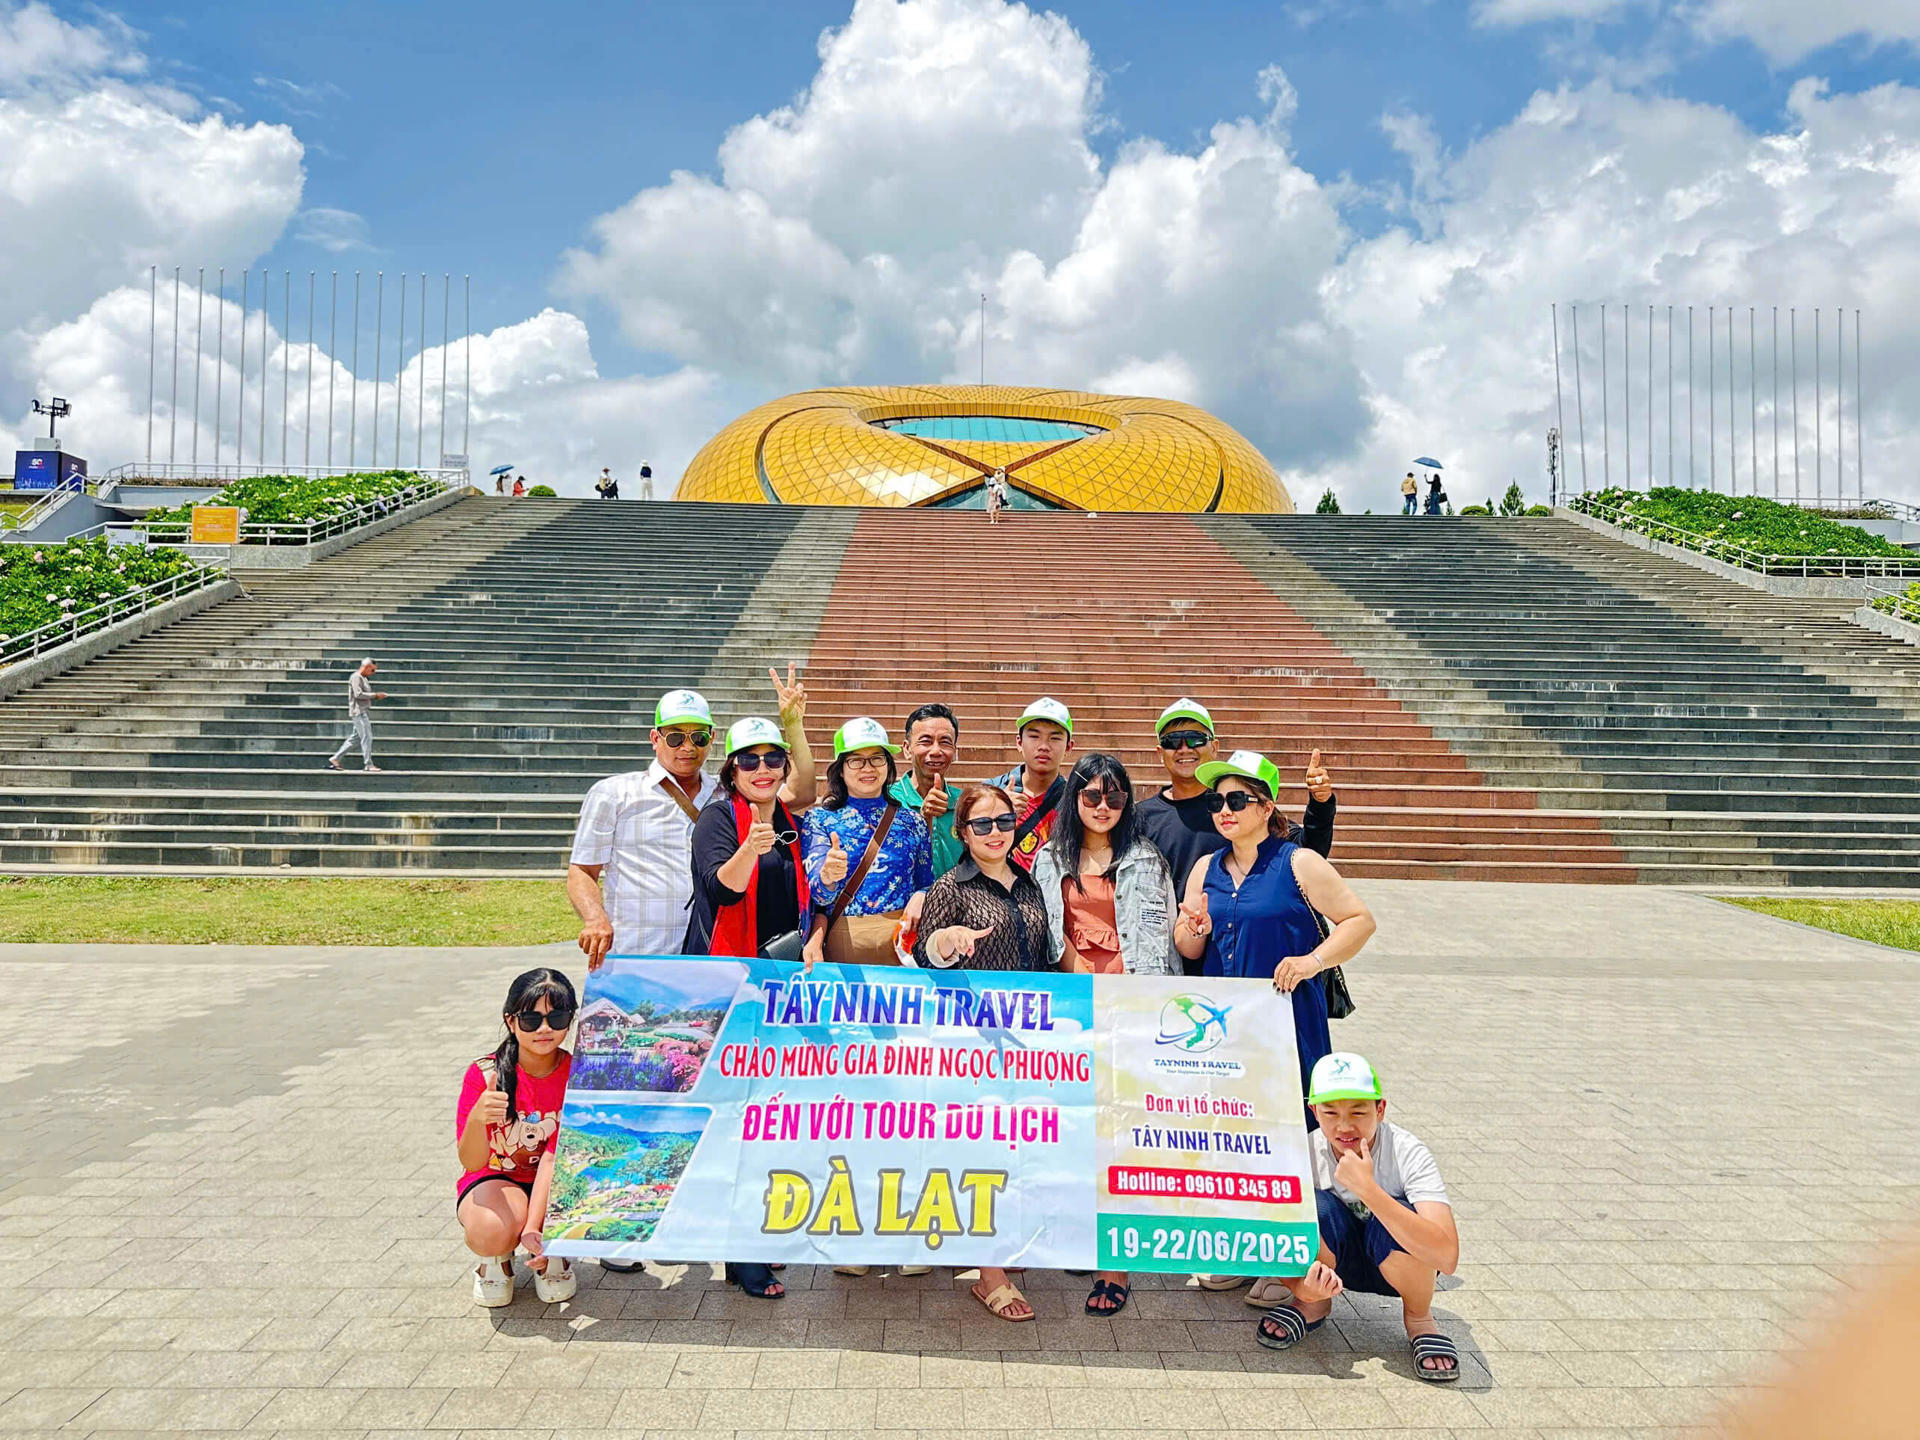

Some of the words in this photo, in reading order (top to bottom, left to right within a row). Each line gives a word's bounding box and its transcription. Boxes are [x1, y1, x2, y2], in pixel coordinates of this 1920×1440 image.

[763, 975, 829, 1025] TÂY
[833, 982, 924, 1026] NINH
[934, 988, 1055, 1031] TRAVEL
[720, 1038, 775, 1077] CHÀO
[781, 1038, 838, 1077] MỪNG
[844, 1045, 877, 1077] GIA
[883, 1039, 932, 1077] ĐÌNH
[939, 1047, 998, 1085] NGỌC
[1003, 1049, 1090, 1088] PHƯỢNG
[1154, 1059, 1199, 1068] TAYNINH
[1201, 1061, 1241, 1070] TRAVEL
[742, 1092, 798, 1141] ĐẾN
[810, 1094, 854, 1141] VỚI
[863, 1101, 936, 1140] TOUR
[945, 1103, 983, 1141] DU
[993, 1105, 1059, 1150] LỊCH
[1146, 1094, 1173, 1112] Đơn
[1177, 1096, 1190, 1117] vị
[1194, 1093, 1208, 1114] tổ
[1212, 1098, 1253, 1117] chức:
[1132, 1125, 1165, 1148] TÂY
[1167, 1130, 1209, 1151] NINH
[1213, 1132, 1272, 1155] TRAVEL
[761, 1155, 864, 1236] ĐÀ
[873, 1167, 1009, 1251] LẠT
[1117, 1171, 1182, 1193] Hotline:
[1185, 1175, 1235, 1196] 09610
[1238, 1178, 1268, 1198] 345
[1272, 1180, 1292, 1199] 89
[1107, 1227, 1310, 1265] 19-22/06/2025
